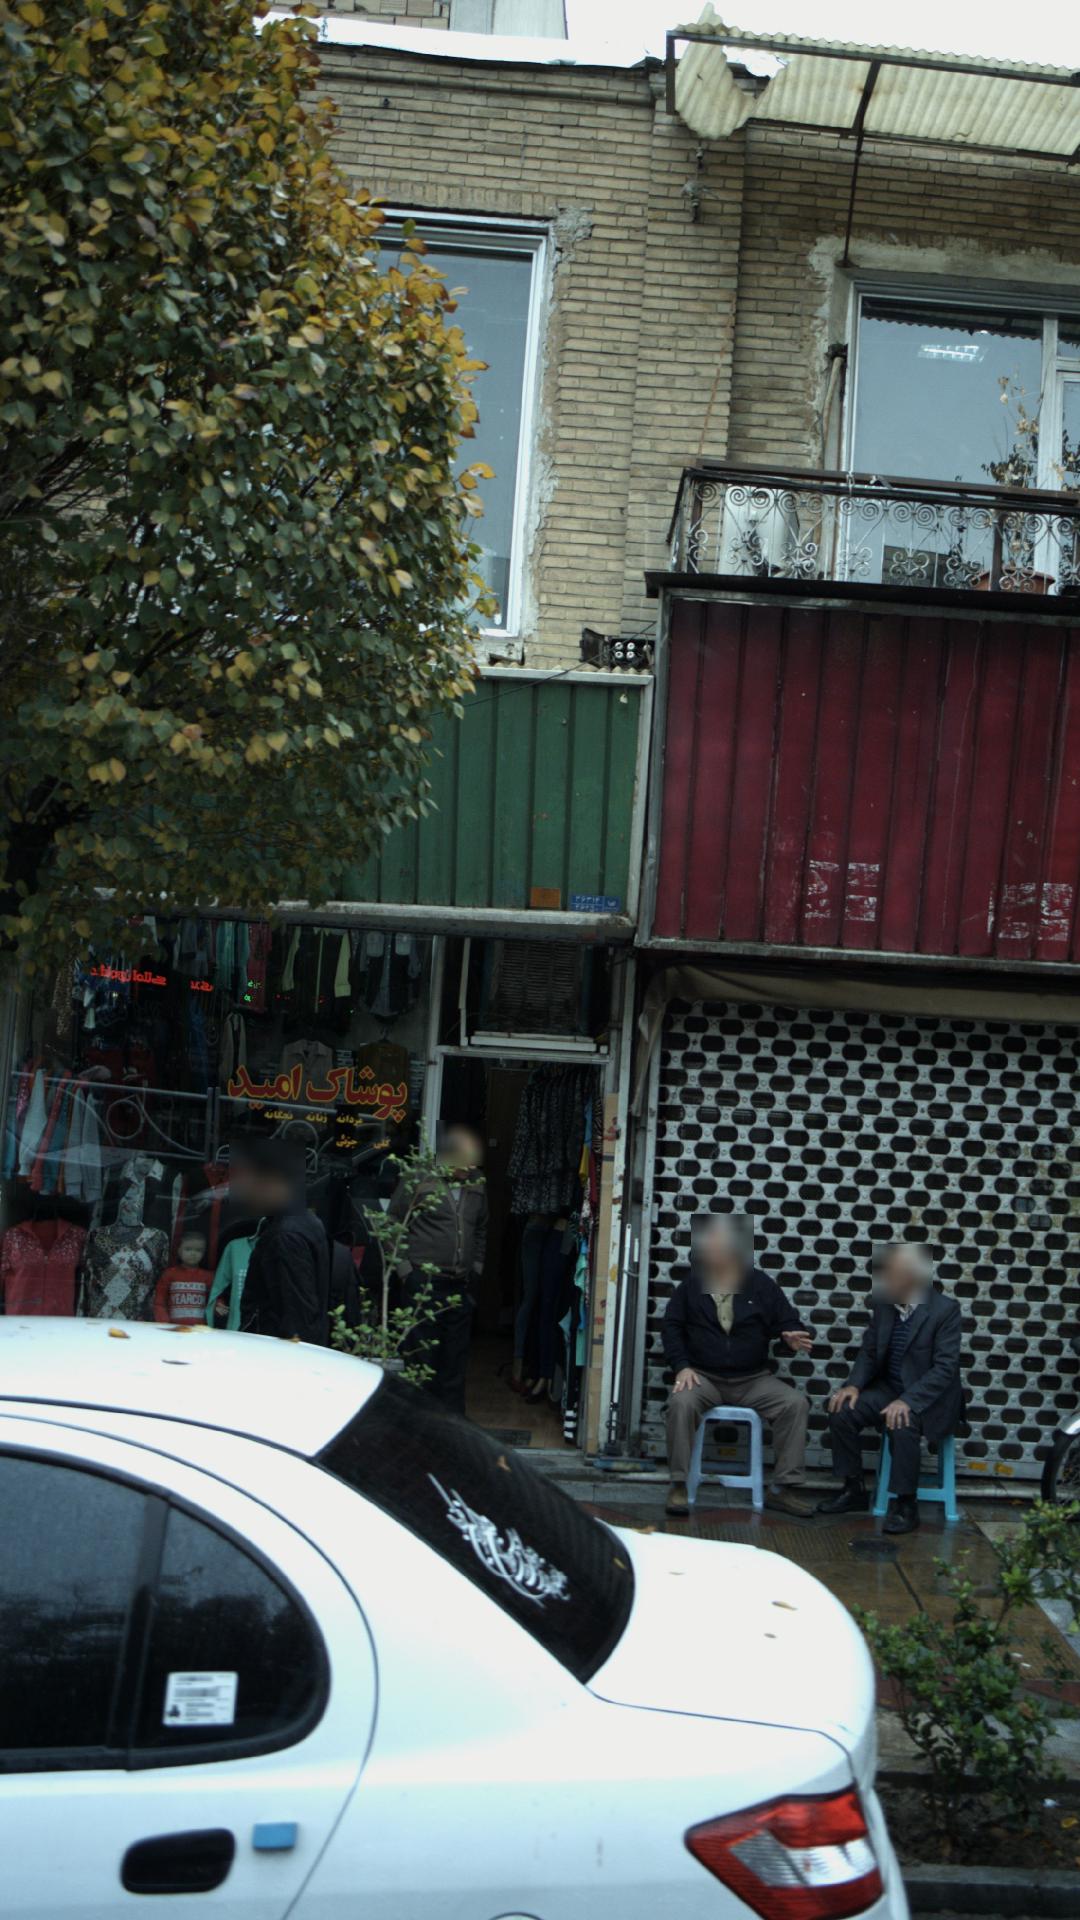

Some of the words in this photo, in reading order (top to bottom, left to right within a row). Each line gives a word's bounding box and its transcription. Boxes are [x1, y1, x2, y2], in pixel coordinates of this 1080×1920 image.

[227, 1062, 303, 1110] امید
[306, 1064, 408, 1125] پوشاک
[305, 1111, 328, 1124] زنانه
[335, 1112, 364, 1126] مردانه
[371, 1138, 391, 1149] کلی
